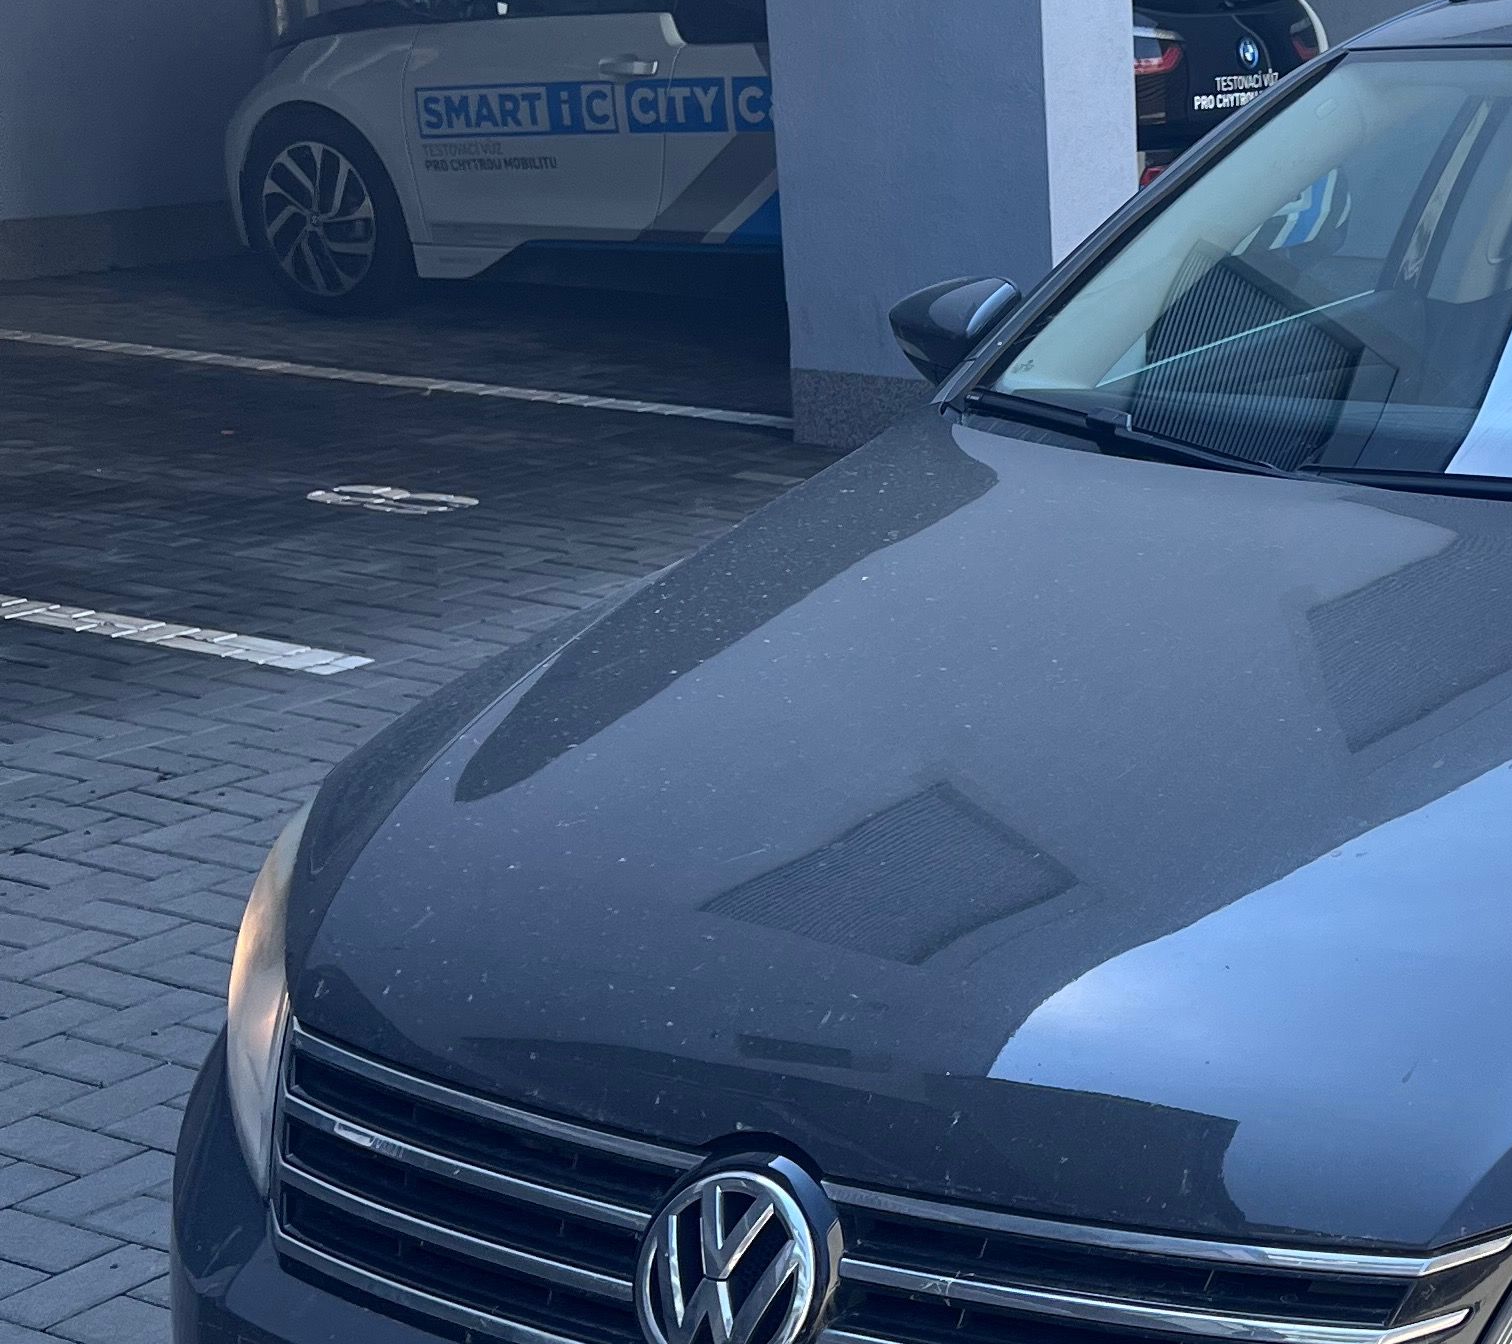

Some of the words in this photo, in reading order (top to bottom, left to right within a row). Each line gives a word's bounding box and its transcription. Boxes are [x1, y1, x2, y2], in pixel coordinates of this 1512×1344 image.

[424, 92, 541, 129] SMART
[631, 86, 718, 125] CITY
[1193, 95, 1215, 111] PRO
